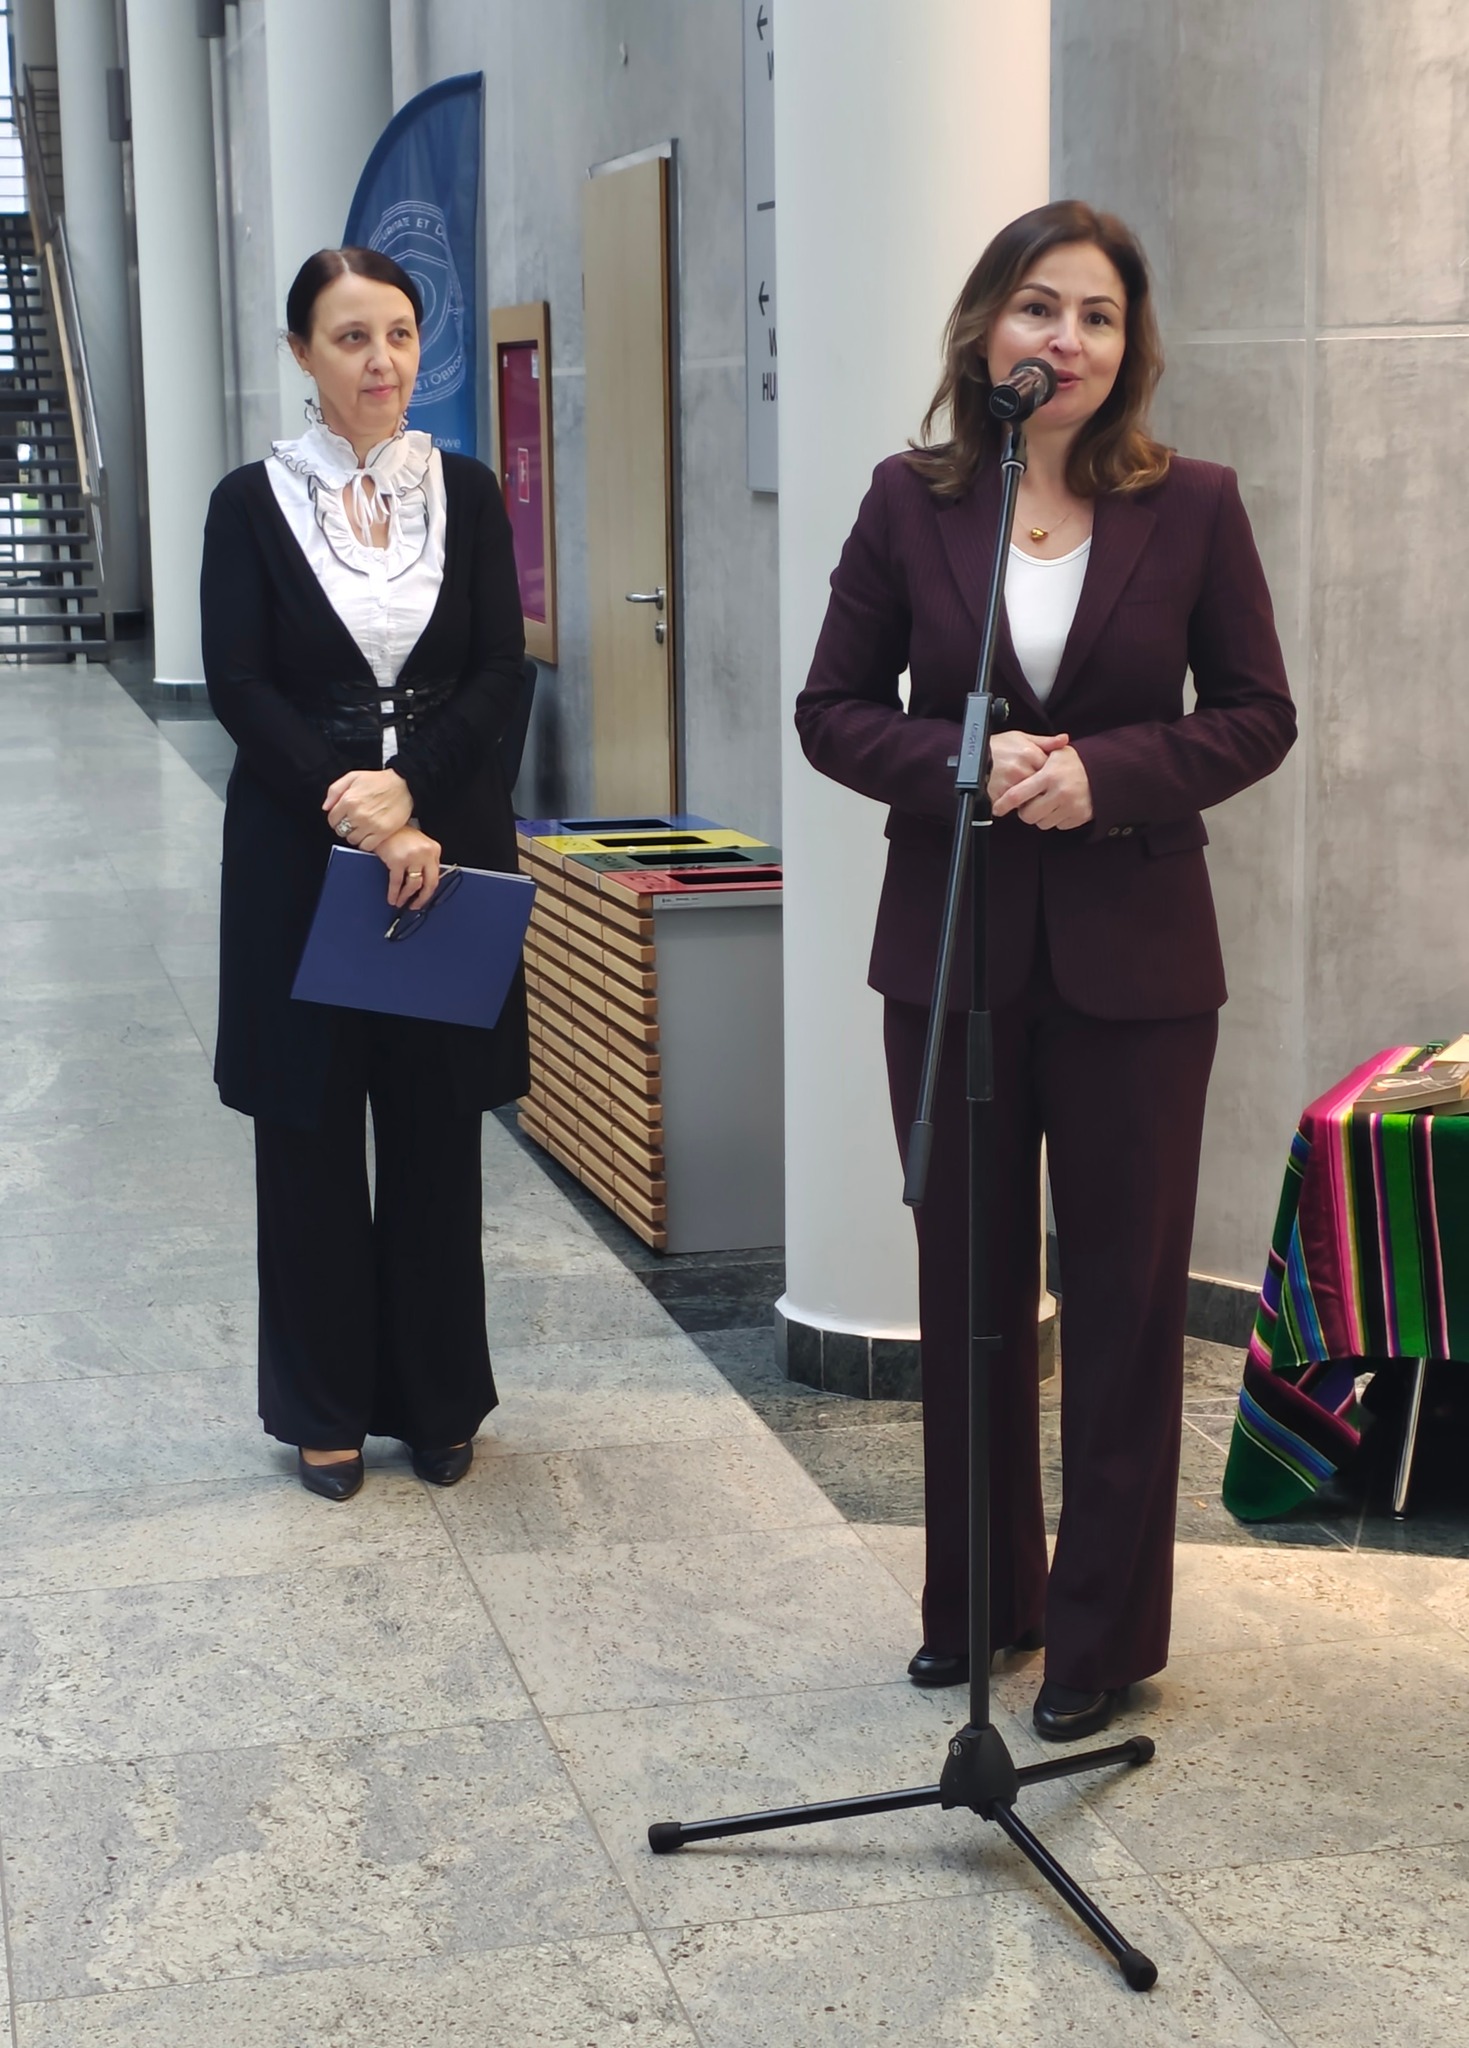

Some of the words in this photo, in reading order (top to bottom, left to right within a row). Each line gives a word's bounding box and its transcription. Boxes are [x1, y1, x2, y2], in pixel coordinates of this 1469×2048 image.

[416, 217, 431, 229] ET
[430, 355, 462, 385] OBRO
[762, 372, 778, 401] HU
[434, 437, 462, 449] owe
